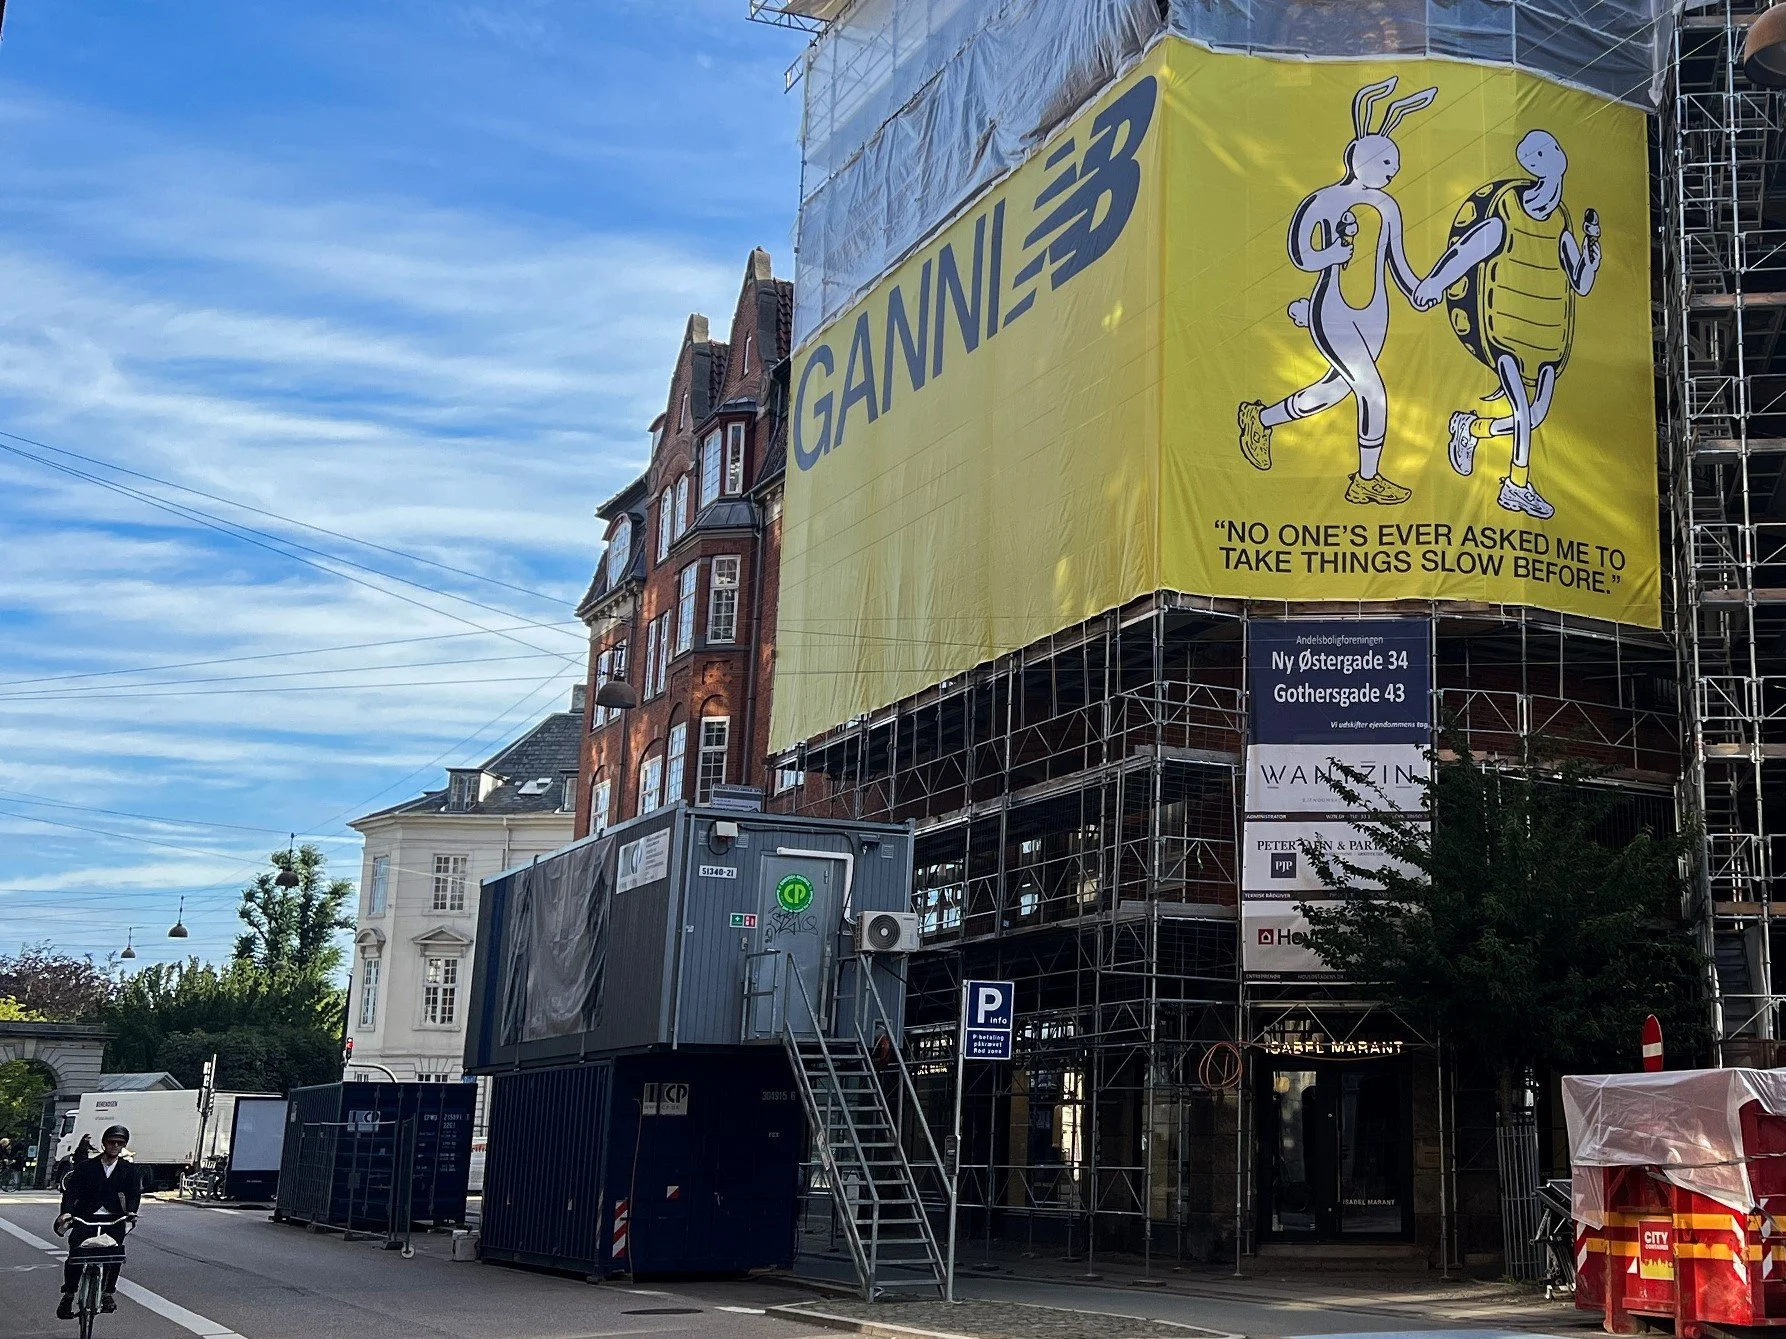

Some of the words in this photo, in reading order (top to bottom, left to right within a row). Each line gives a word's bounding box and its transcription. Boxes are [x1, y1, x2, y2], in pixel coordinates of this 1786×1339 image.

[793, 197, 1005, 471] GANNI
[1214, 520, 1269, 545] “NO
[1279, 524, 1368, 547] ONE’S
[1378, 524, 1452, 546] EVER
[1461, 525, 1549, 556] ASKED
[1556, 538, 1589, 564] ME
[1595, 545, 1626, 571] TO
[1219, 547, 1292, 573] TAKE
[1301, 550, 1412, 574] THINGS
[1421, 550, 1504, 577] SLOW
[1514, 556, 1621, 595] BEFORE.”
[1296, 635, 1384, 647] Andelsboligforeningen
[1271, 651, 1294, 674] Ny
[1298, 649, 1383, 674] Østergade
[1388, 650, 1409, 669] 34
[1274, 682, 1380, 707] Gothersgade
[1384, 683, 1406, 703] 43
[1330, 721, 1338, 729] Vi
[1338, 721, 1368, 730] udskifter
[1369, 721, 1416, 730] ejendommens
[1257, 840, 1297, 851] PETER
[1337, 840, 1346, 851] &
[1275, 860, 1293, 873] PJP
[783, 883, 806, 904] CP
[977, 987, 1003, 1024] P
[1331, 1040, 1404, 1055] MARANT
[1644, 1231, 1669, 1244] CITY
